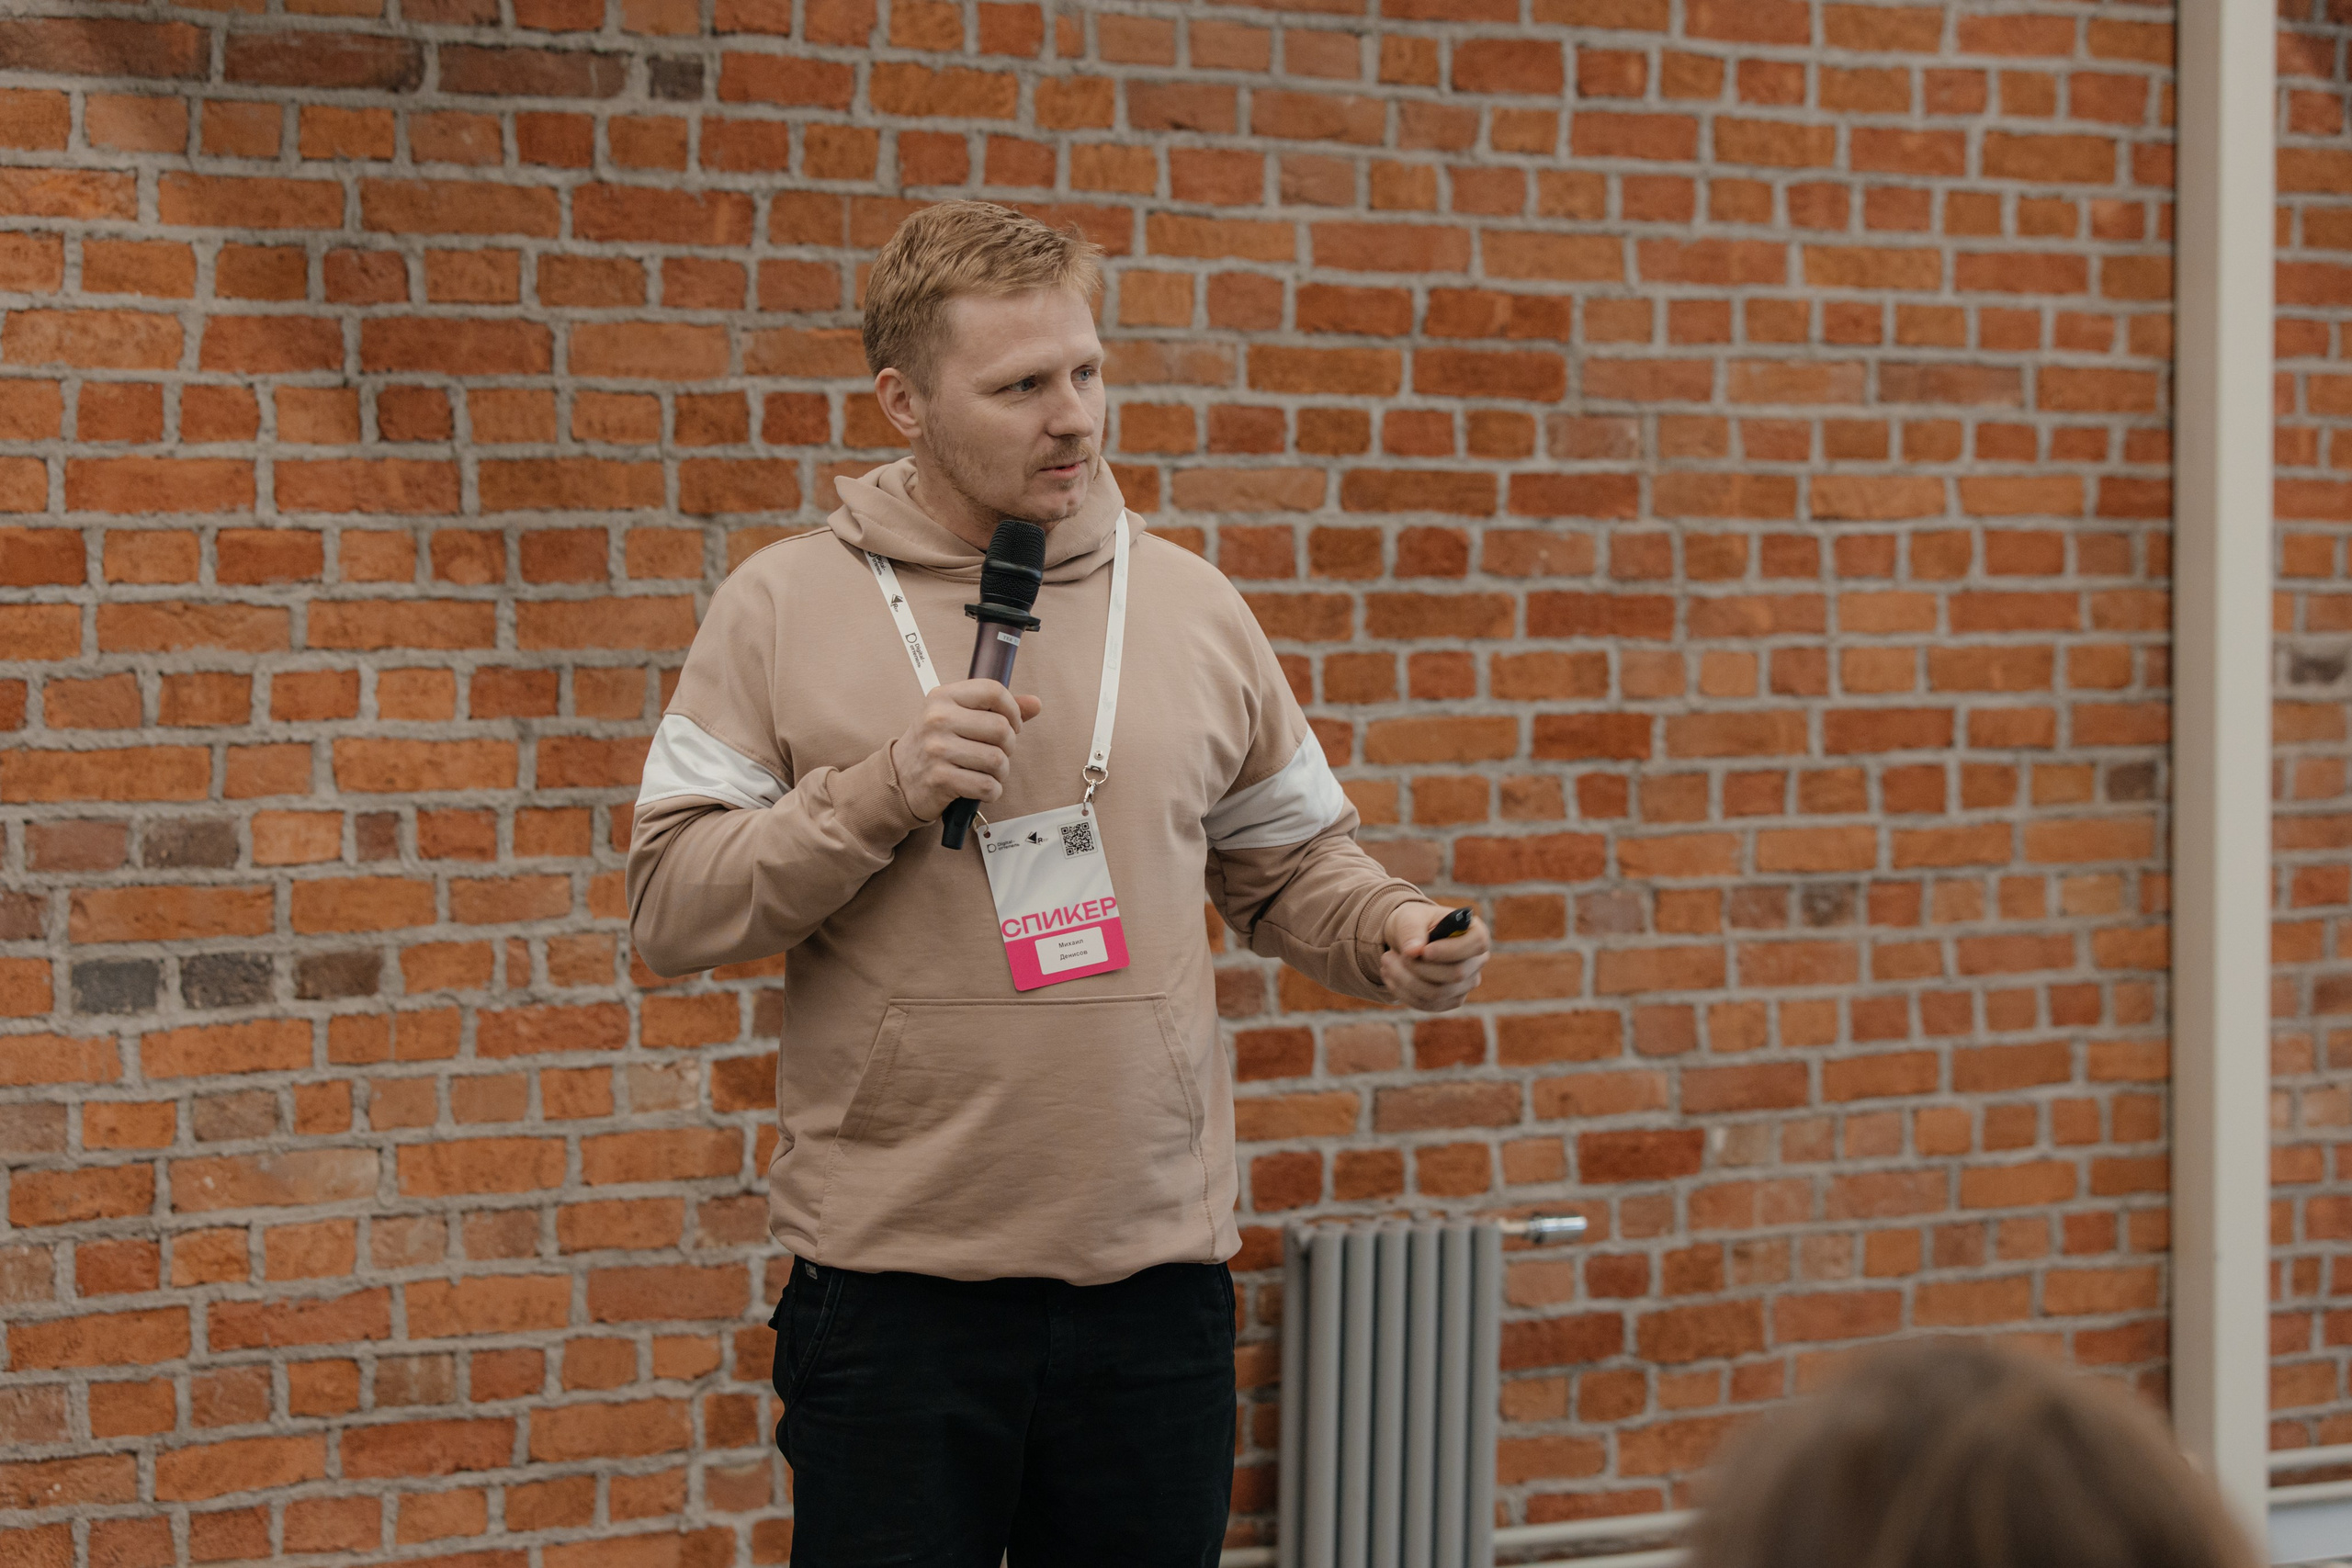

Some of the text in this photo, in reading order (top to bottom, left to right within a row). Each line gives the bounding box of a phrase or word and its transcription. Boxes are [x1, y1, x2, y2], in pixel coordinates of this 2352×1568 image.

[1001, 897, 1117, 938] СПИКЕР
[1058, 939, 1084, 949] Михаил
[1059, 950, 1088, 961] Денисов
